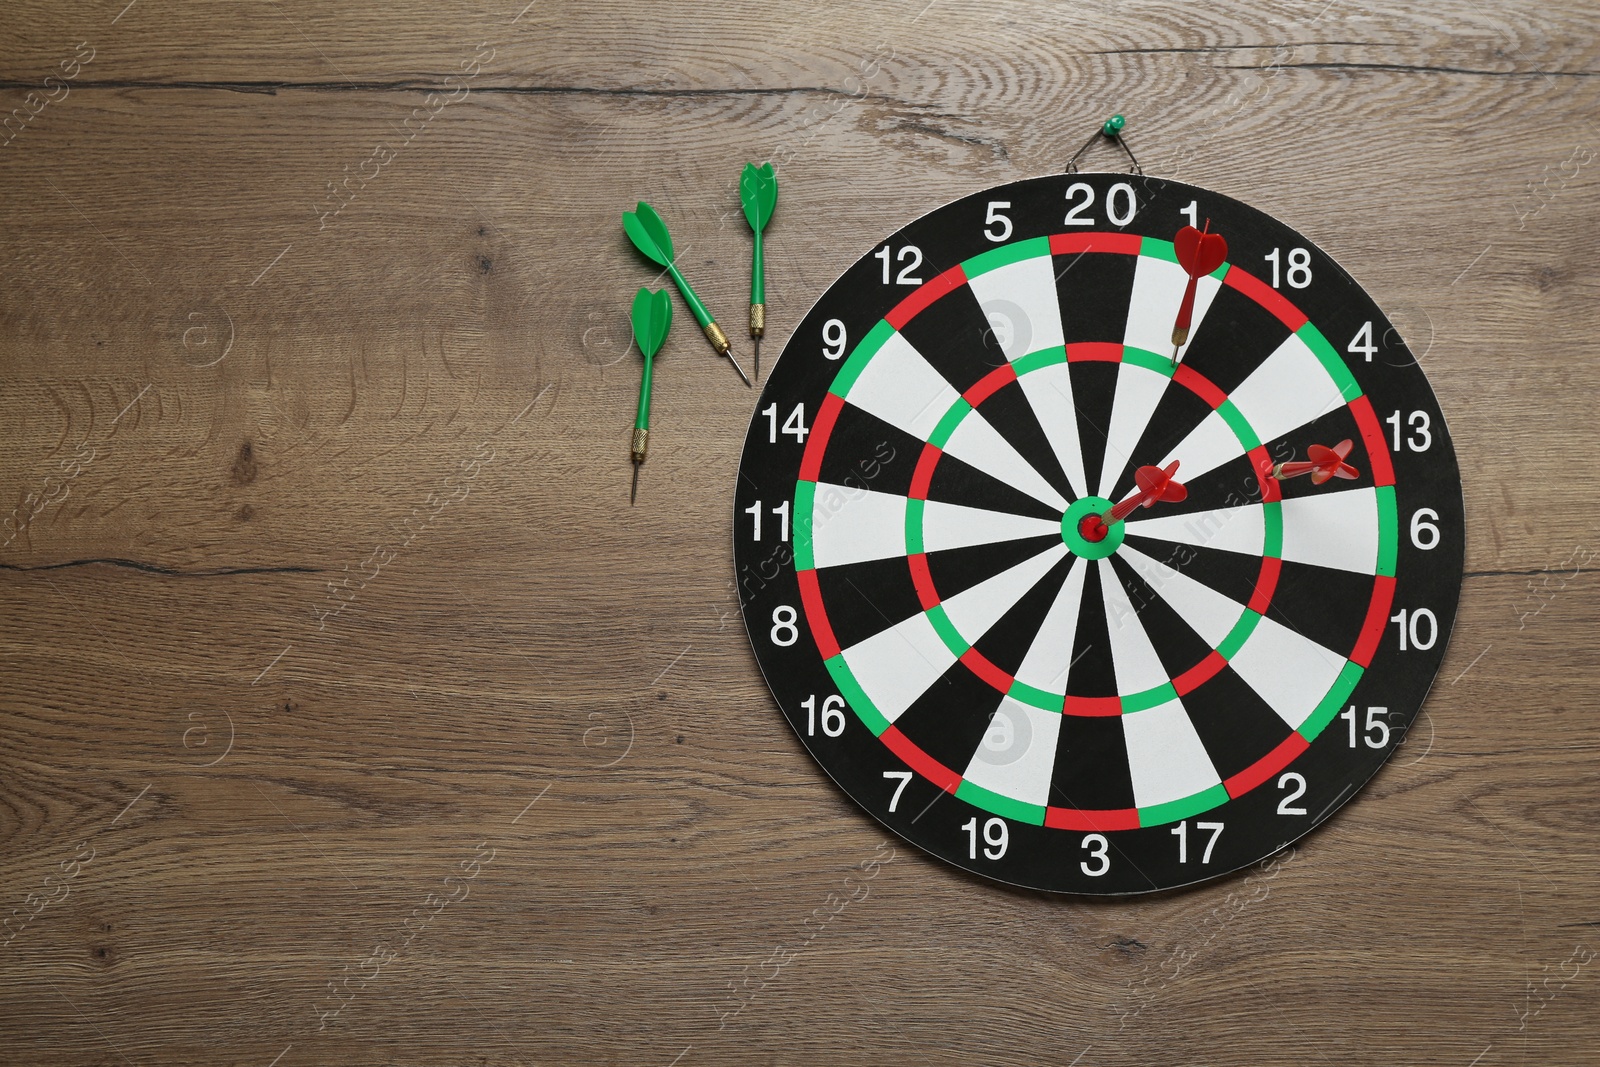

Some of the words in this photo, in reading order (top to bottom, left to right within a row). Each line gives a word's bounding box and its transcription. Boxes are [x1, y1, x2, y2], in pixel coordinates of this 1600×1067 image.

[984, 201, 1012, 243] 5
[1065, 183, 1136, 227] 20
[1180, 201, 1197, 230] 1
[875, 246, 922, 285] 12
[1265, 247, 1312, 288] 18
[823, 318, 846, 361] 9
[1348, 322, 1378, 362] 4
[763, 402, 808, 444] 14
[1387, 410, 1431, 452] 13
[746, 500, 789, 542] 11
[1411, 508, 1440, 551] 6
[771, 605, 798, 647] 8
[1391, 608, 1437, 651] 10
[801, 694, 845, 738] 16
[1341, 705, 1390, 749] 15
[883, 772, 912, 813] 7
[1277, 773, 1306, 816] 2
[962, 818, 1008, 861] 19
[1081, 834, 1110, 877] 3
[1172, 821, 1224, 864] 17
